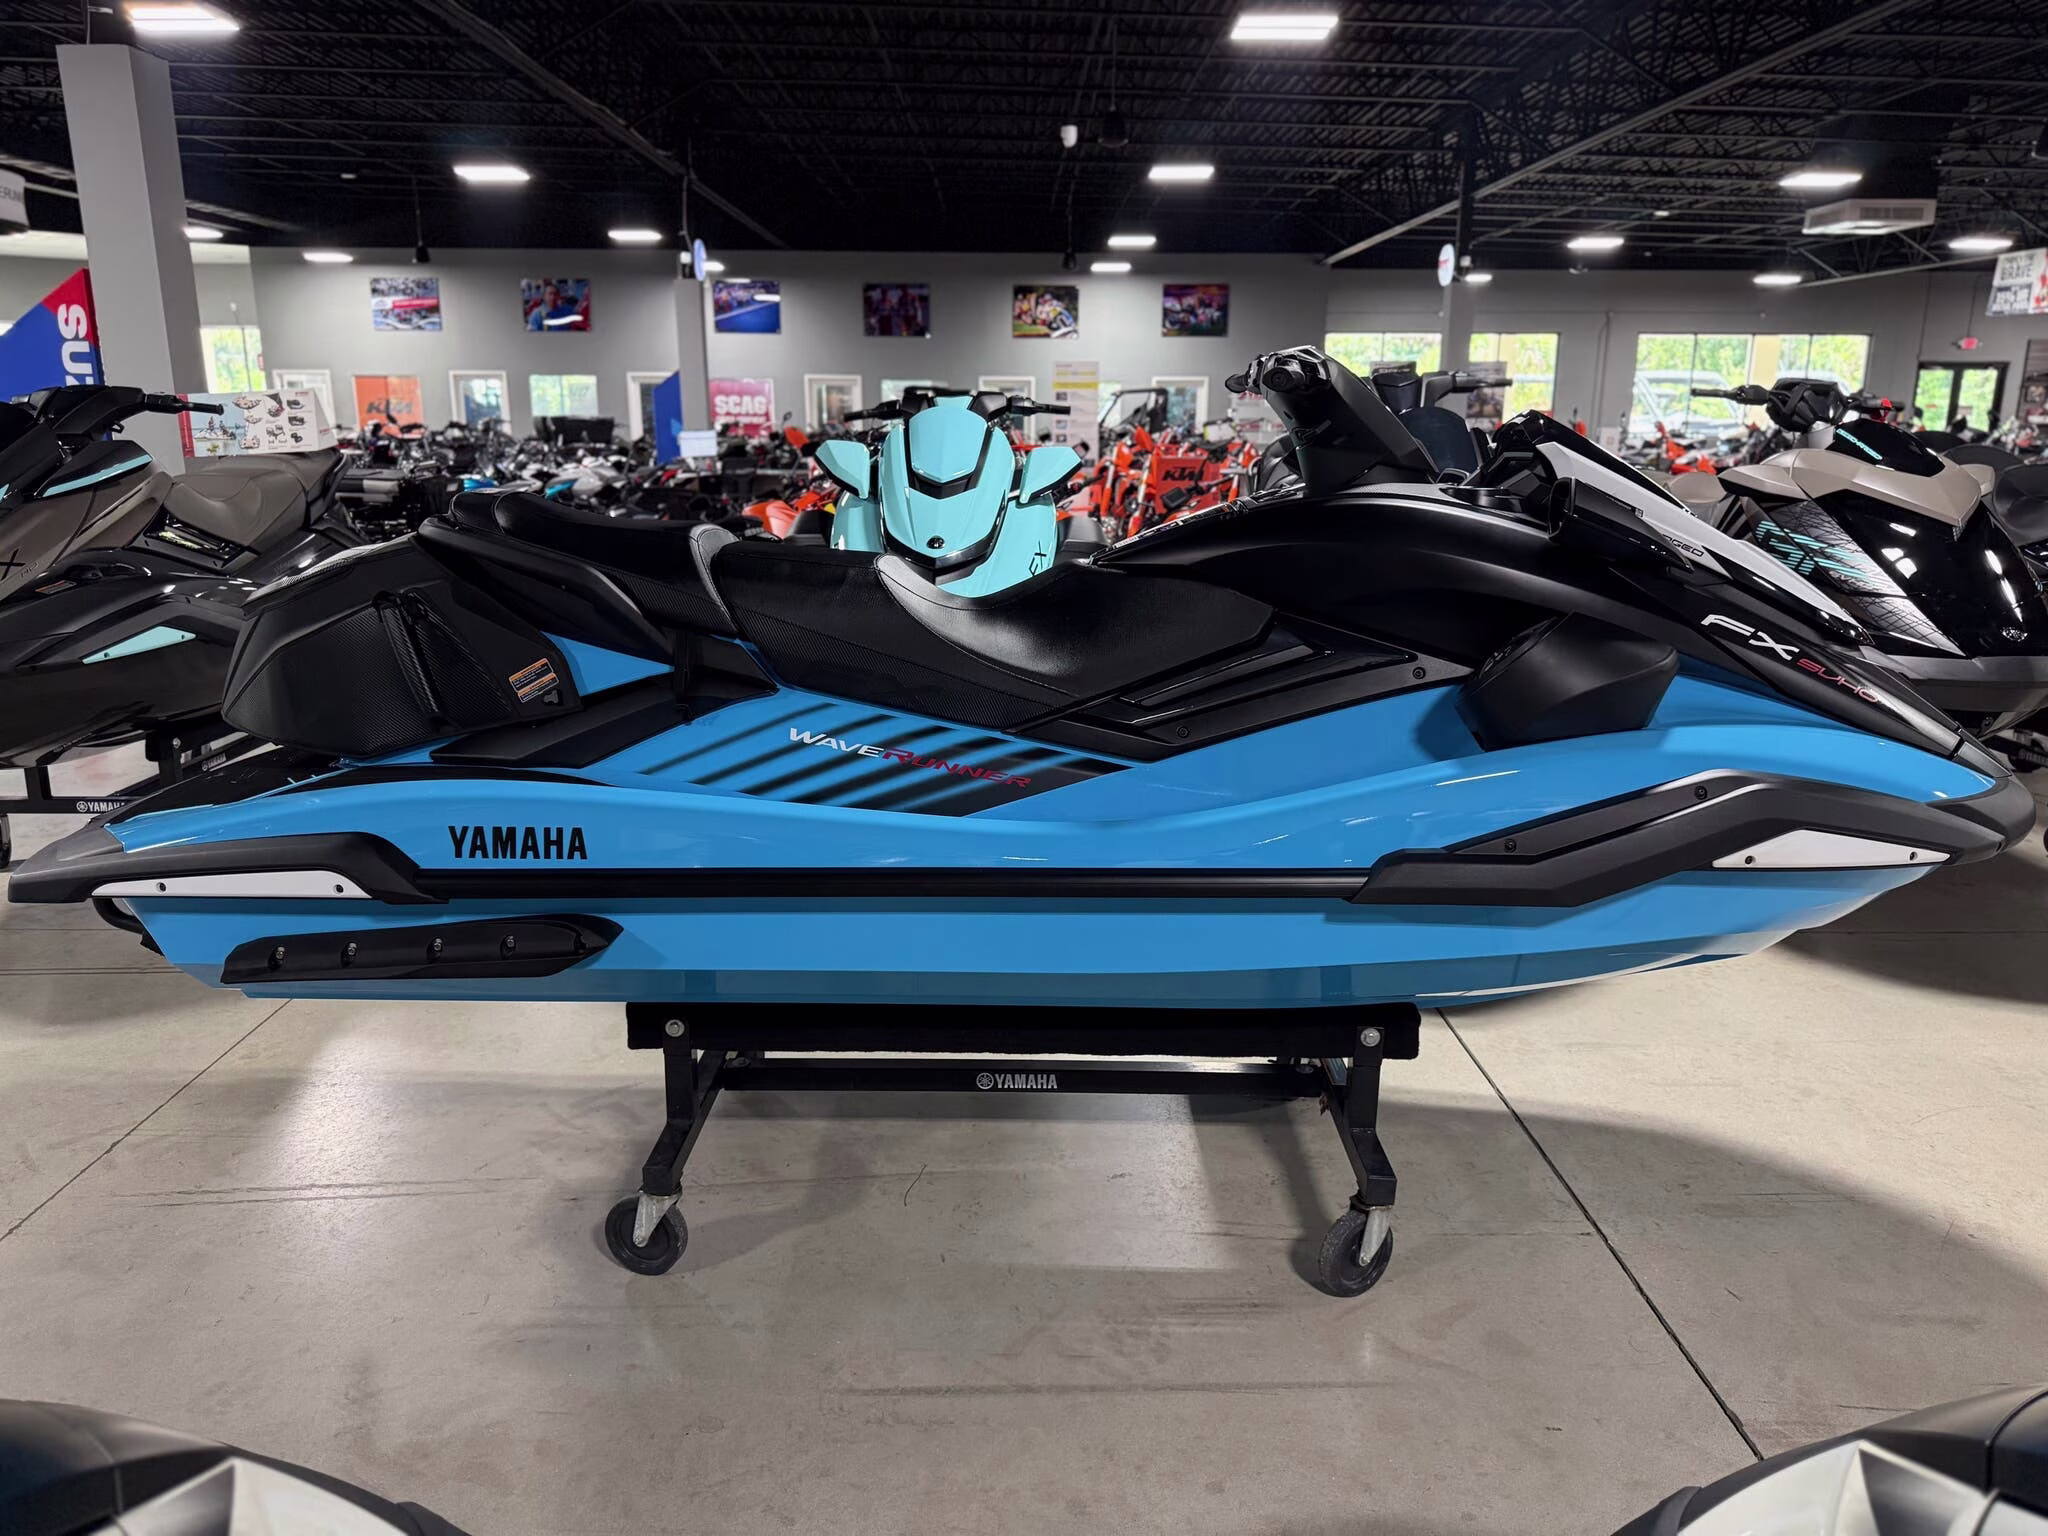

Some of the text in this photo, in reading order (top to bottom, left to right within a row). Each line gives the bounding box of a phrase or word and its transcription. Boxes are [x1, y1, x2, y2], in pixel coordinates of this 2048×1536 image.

[714, 395, 767, 414] SCAG
[1163, 468, 1203, 480] KTM
[1700, 614, 1879, 703] FX SVHO
[789, 727, 1032, 788] WAVERUNNER
[87, 801, 125, 812] YAMAH
[448, 826, 587, 860] YAMAHA
[995, 1073, 1058, 1089] YAMAHA
